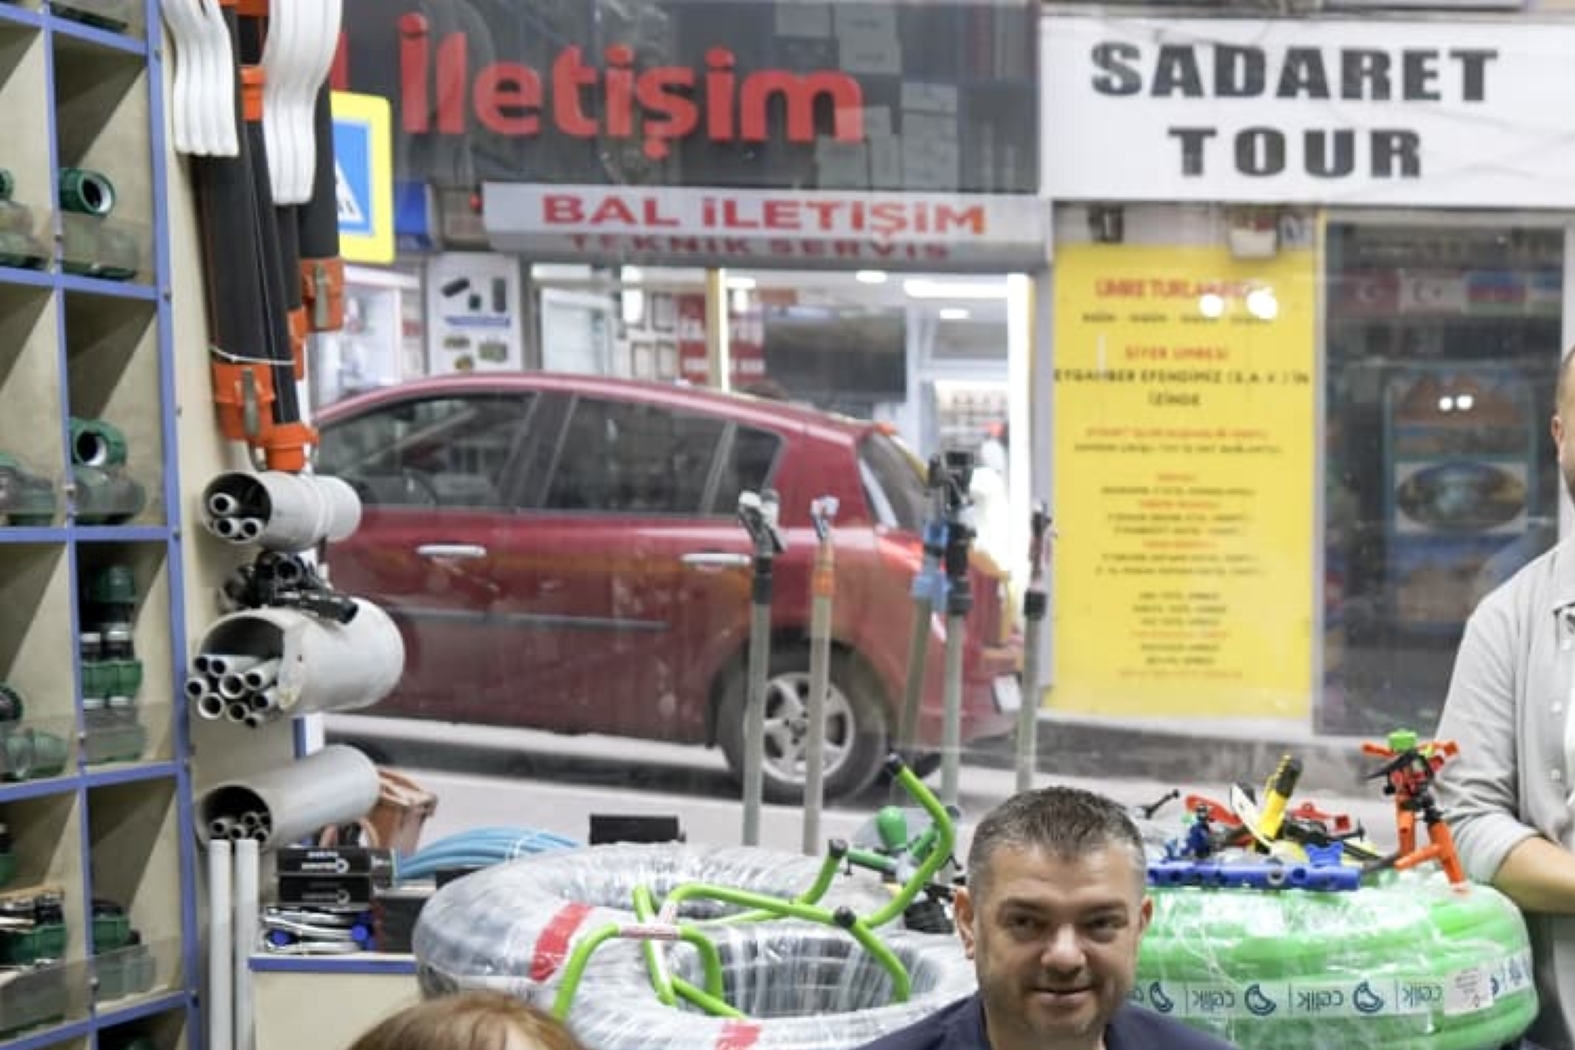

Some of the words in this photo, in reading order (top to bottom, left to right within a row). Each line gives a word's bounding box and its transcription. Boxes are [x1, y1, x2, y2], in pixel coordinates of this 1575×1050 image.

[400, 12, 864, 160] İletişim
[1091, 42, 1498, 102] SADARET
[1168, 126, 1421, 178] TOUR
[542, 195, 681, 226] BAL
